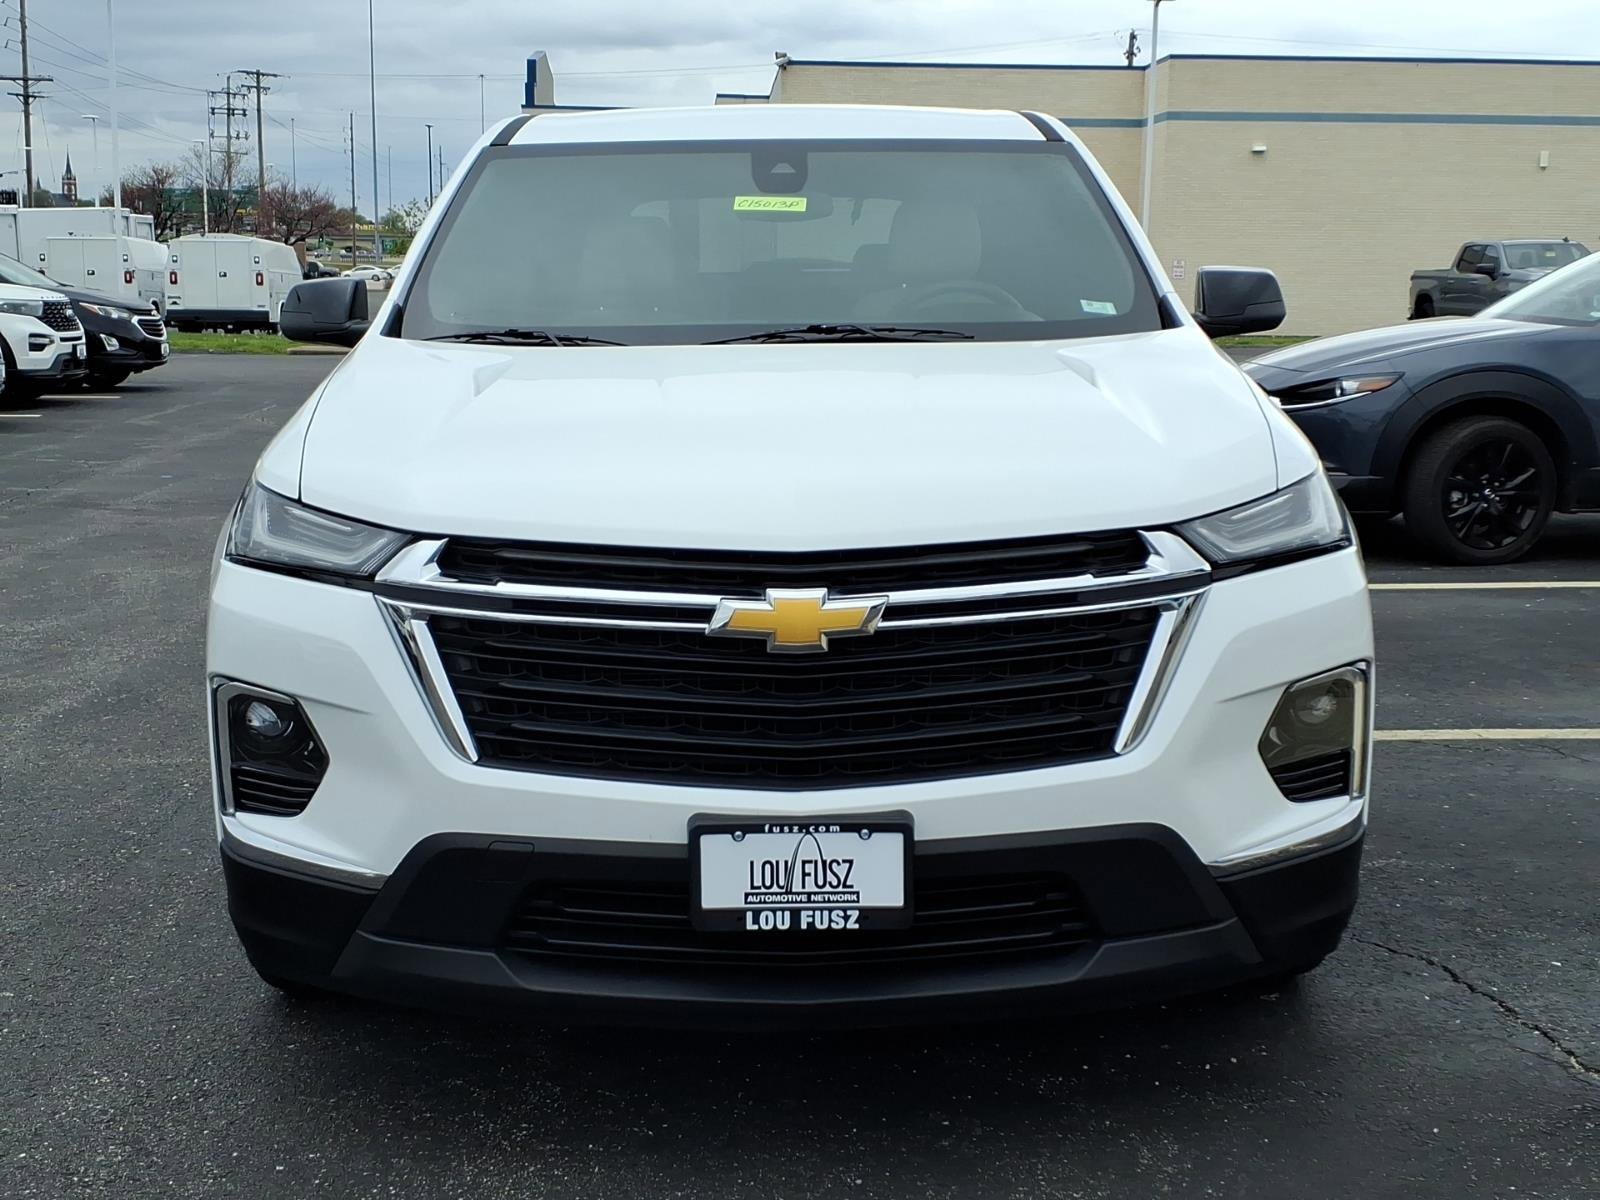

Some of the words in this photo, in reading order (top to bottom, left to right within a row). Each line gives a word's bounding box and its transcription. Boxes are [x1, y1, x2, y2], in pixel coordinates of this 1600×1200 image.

[764, 824, 840, 833] fusz.com
[749, 860, 789, 890] LOU
[801, 859, 855, 889] FUSZ
[746, 893, 808, 903] AUTOMOTIVE
[811, 893, 858, 902] NETWORK
[746, 910, 791, 930] LOU
[801, 909, 860, 930] FUSZ
